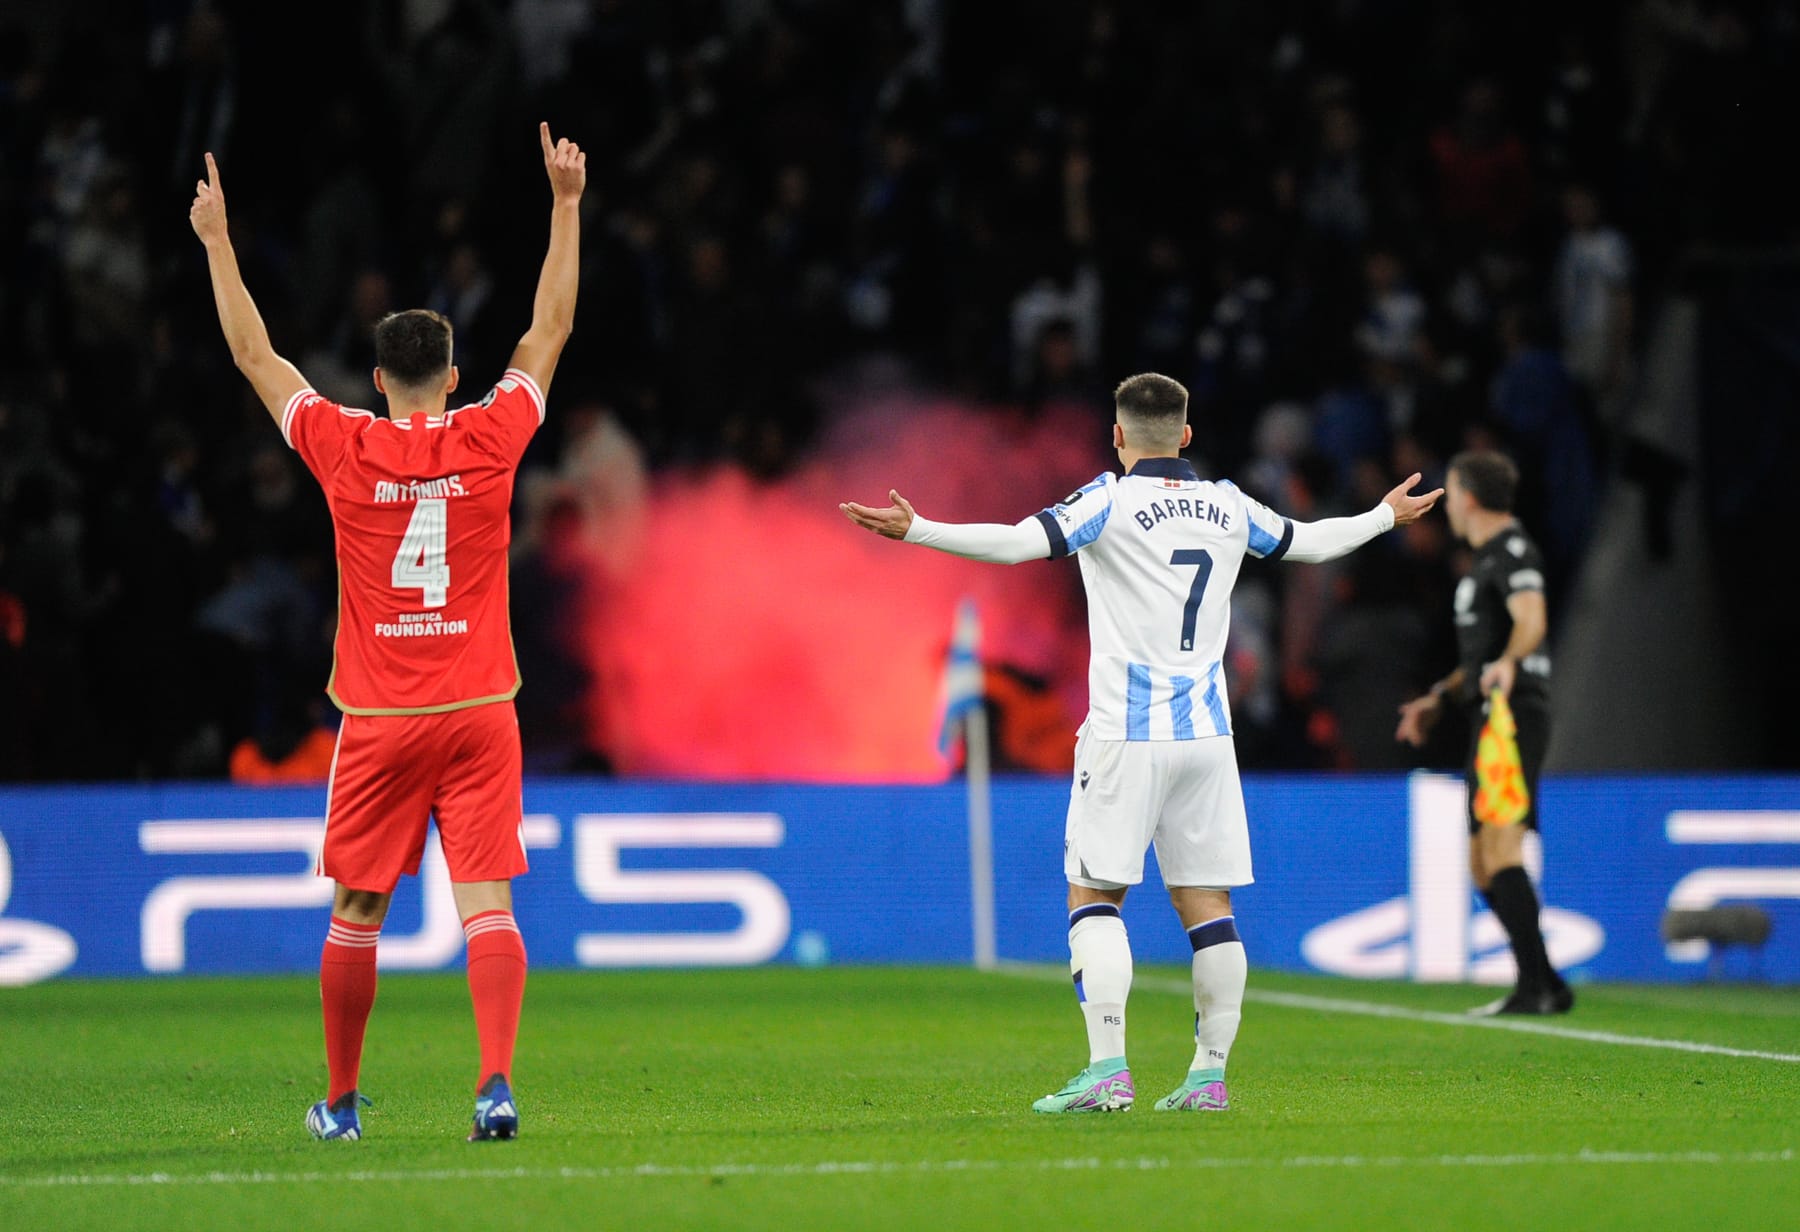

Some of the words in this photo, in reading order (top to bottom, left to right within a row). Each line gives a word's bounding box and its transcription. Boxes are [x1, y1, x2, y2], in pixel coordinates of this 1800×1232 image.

[1134, 499, 1232, 532] BARRENE
[391, 498, 450, 608] 4
[1169, 548, 1213, 651] 7
[374, 620, 468, 637] FOUNDATION
[399, 612, 443, 623] BENFICA
